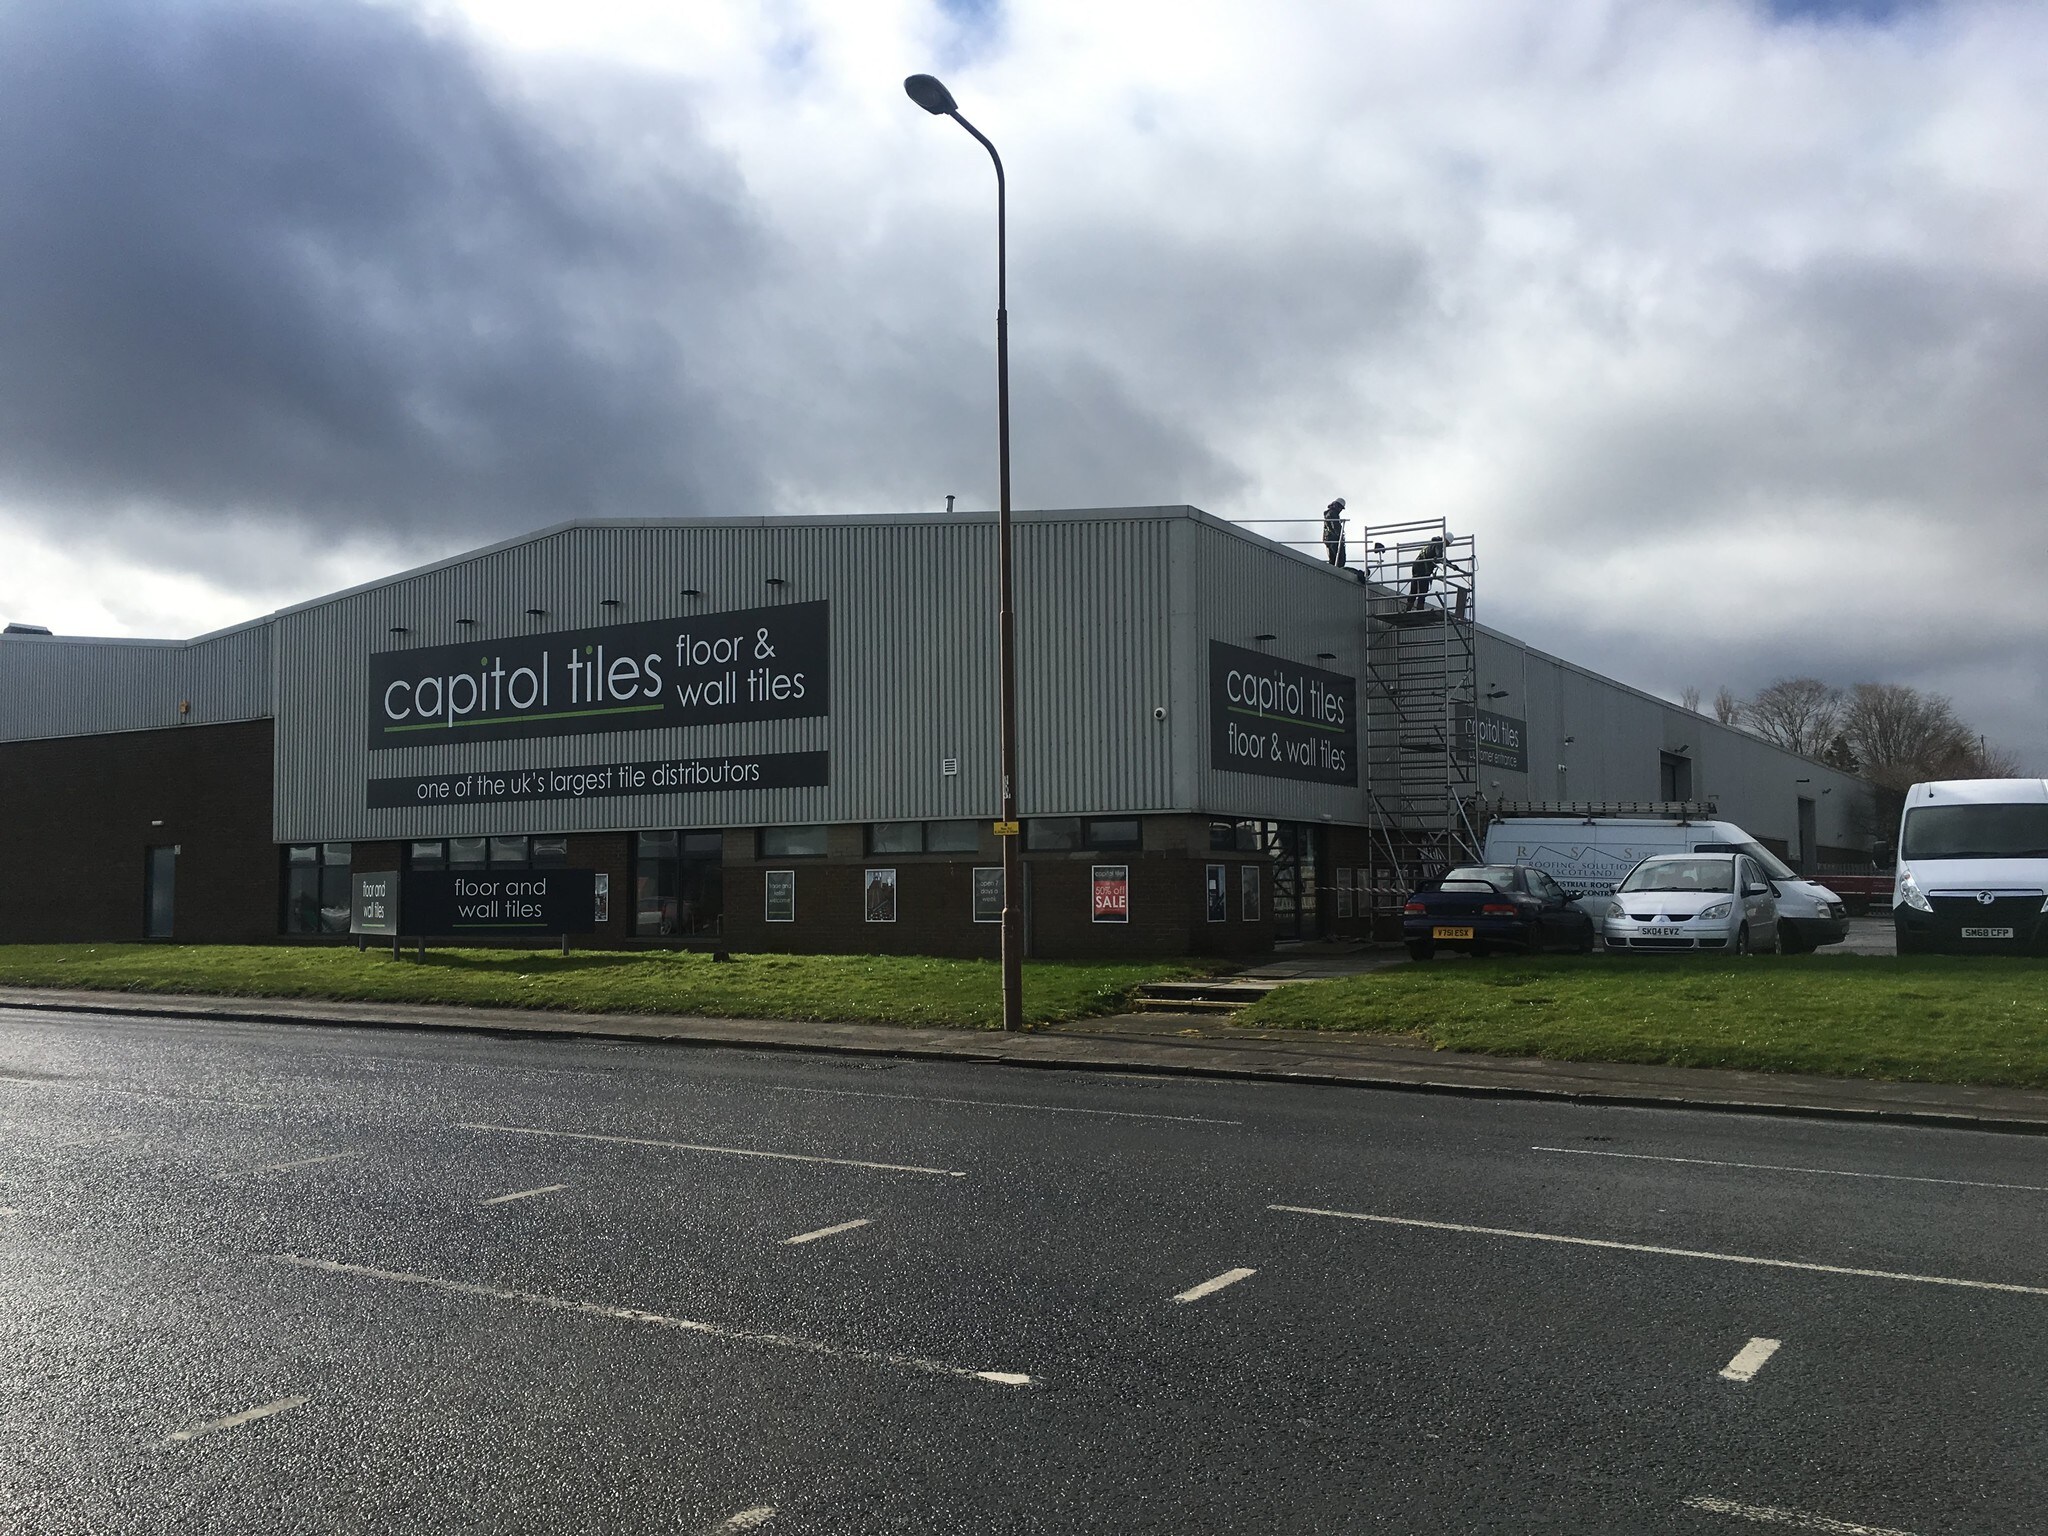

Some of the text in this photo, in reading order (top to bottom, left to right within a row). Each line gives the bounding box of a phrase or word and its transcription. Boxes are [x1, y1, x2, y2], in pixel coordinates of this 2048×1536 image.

[676, 627, 776, 667] floor &
[384, 645, 663, 727] capitol tiles
[676, 668, 805, 707] wall tiles
[1226, 669, 1345, 724] capitol tiles
[1502, 721, 1519, 748] tiles
[1228, 722, 1346, 771] floor & wall tiles
[417, 760, 760, 800] one of the uk's largest tile distributors
[1517, 846, 1527, 857] R
[1570, 847, 1579, 858] S
[1624, 848, 1633, 859] S
[1528, 861, 1634, 871] ROOFING SOLUTION
[362, 880, 386, 897] floor and
[455, 877, 547, 896] floor and
[362, 902, 384, 918] wall tiles
[458, 900, 542, 918] wall tiles
[1095, 895, 1126, 908] SALE
[1642, 928, 1680, 936] SK04 EVZ
[1965, 928, 2009, 937] SM68 CFP
